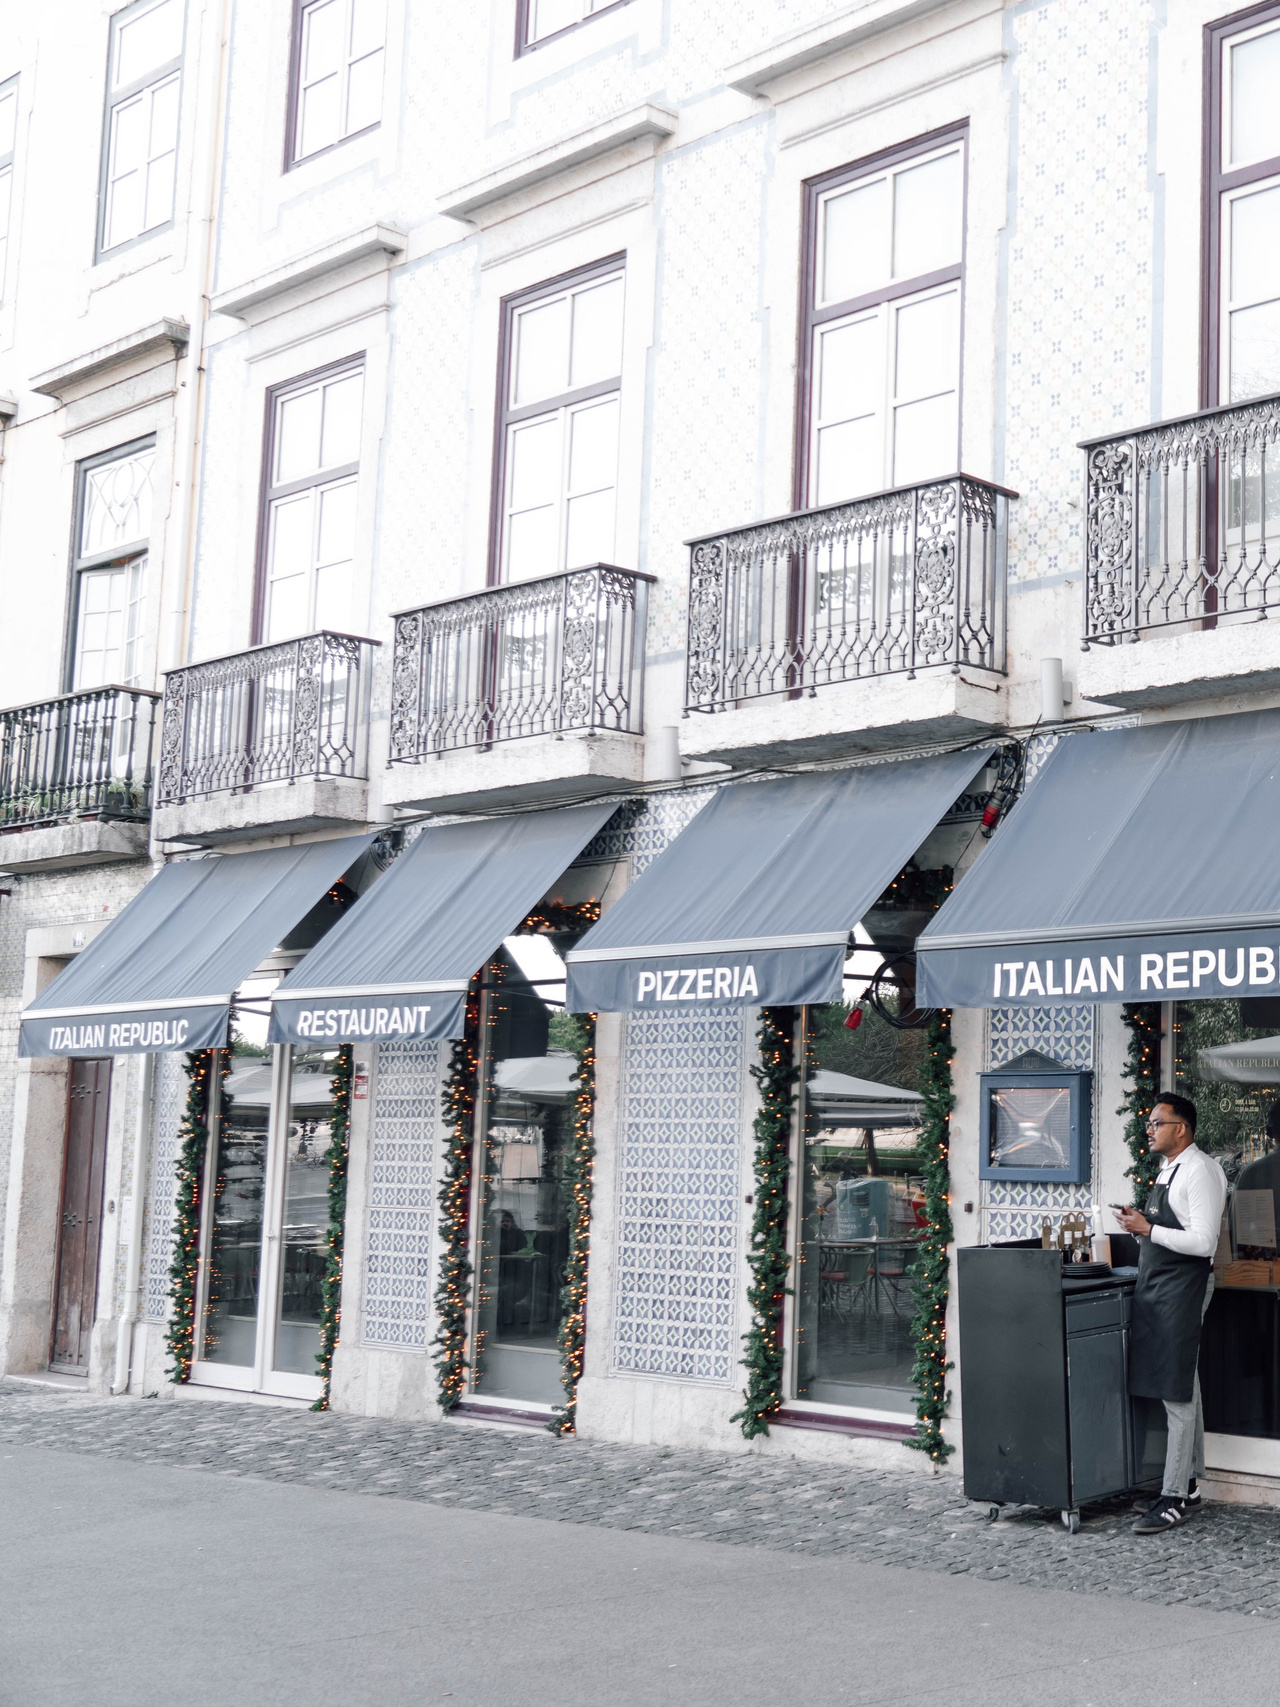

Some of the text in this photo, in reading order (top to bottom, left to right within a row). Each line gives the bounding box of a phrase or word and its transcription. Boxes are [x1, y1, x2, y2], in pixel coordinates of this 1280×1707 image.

[637, 965, 759, 1002] PIZZERIA
[993, 955, 1124, 998] ITALIAN
[48, 1019, 189, 1050] ITALIAN REPUBLIC
[296, 1005, 431, 1036] RESTAURANT
